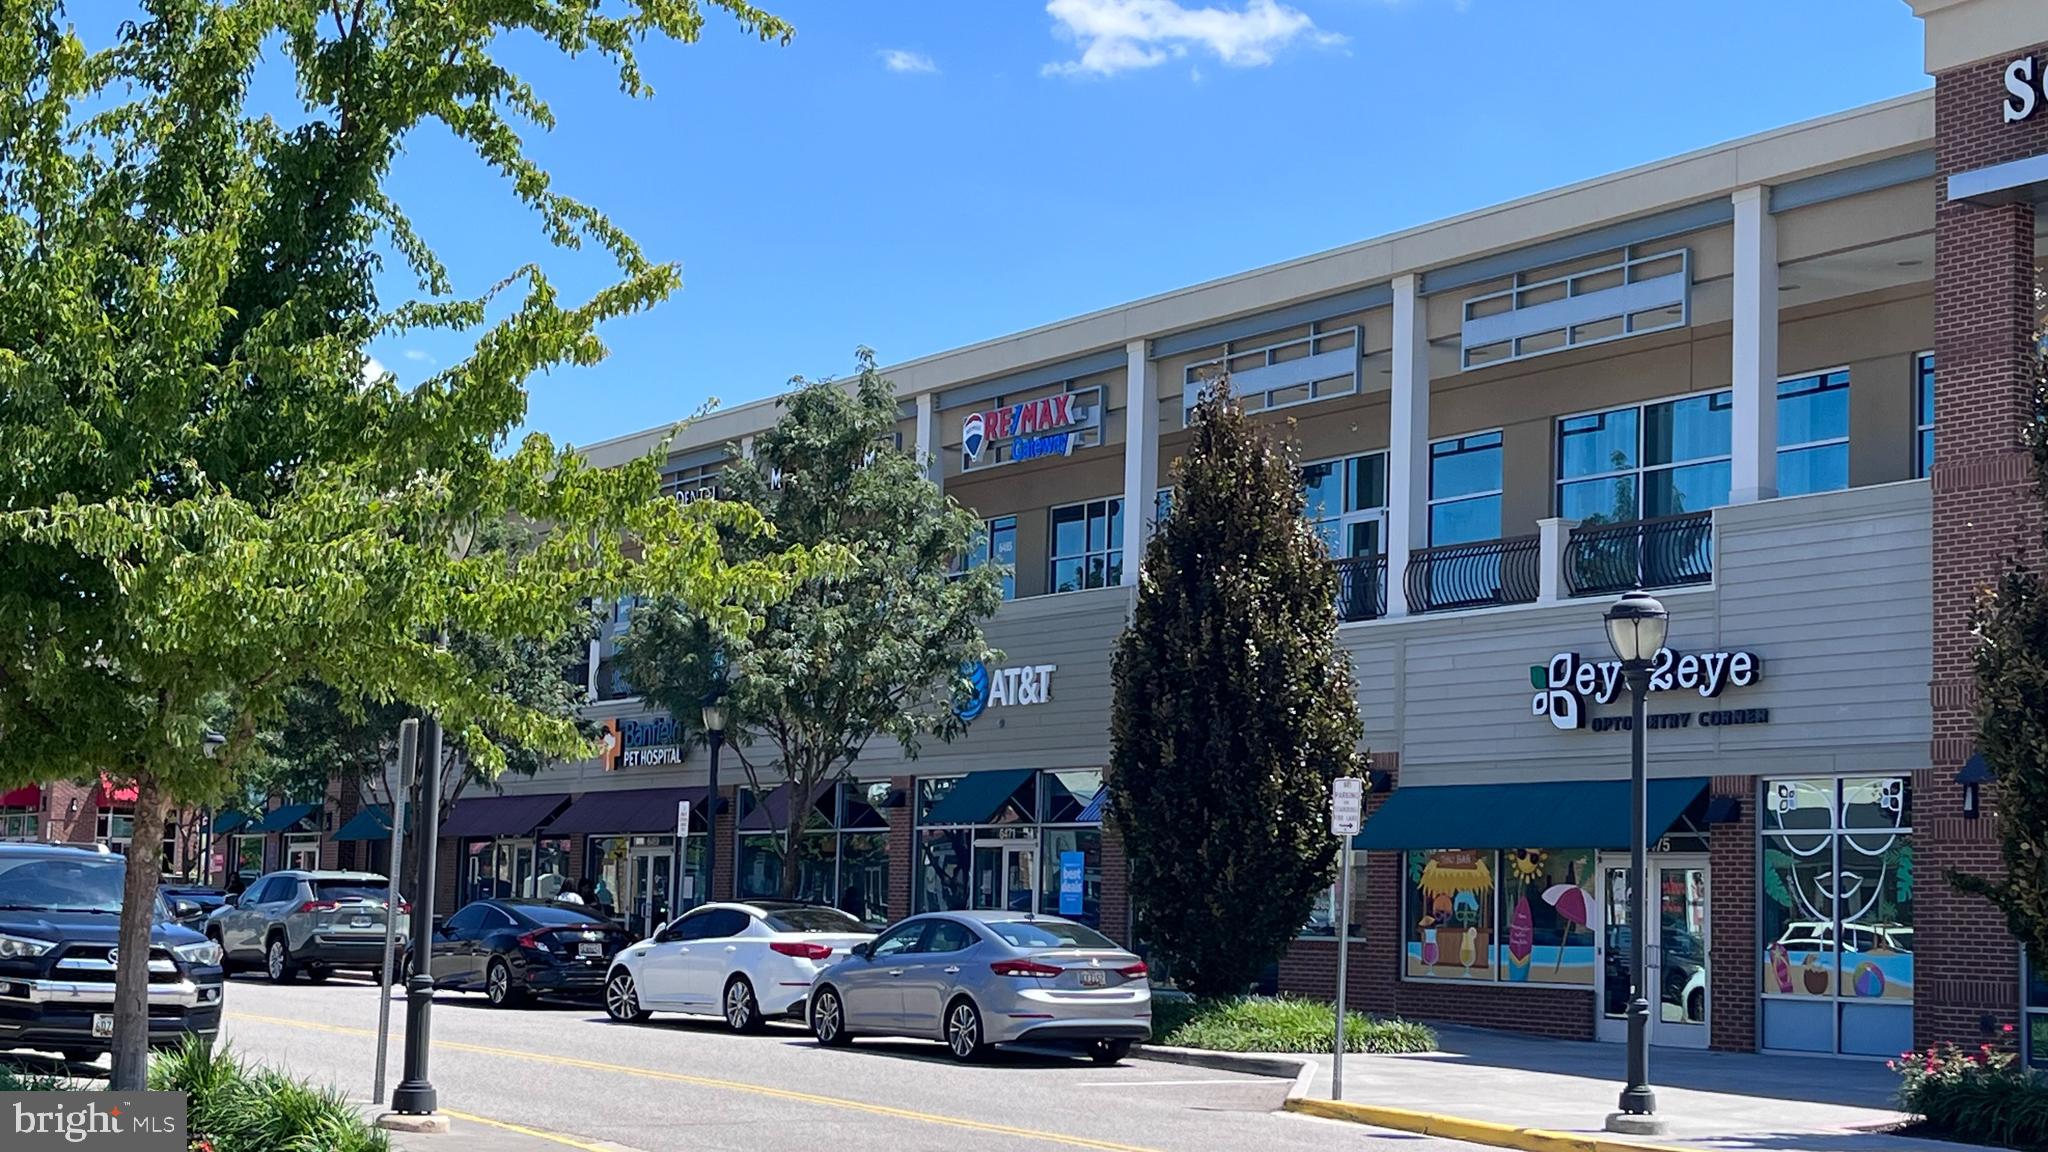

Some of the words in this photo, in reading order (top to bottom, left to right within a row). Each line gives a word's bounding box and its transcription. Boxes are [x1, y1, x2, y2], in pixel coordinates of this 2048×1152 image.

[2003, 55, 2048, 123] S
[984, 394, 1071, 441] RE/MAX
[1010, 431, 1069, 462] Gateway
[987, 664, 1057, 707] AT&T
[1576, 647, 1752, 704] ey2eye
[1591, 712, 1691, 732] OPTOETRY
[1698, 708, 1769, 727] CORNER
[623, 750, 640, 767] PET
[641, 747, 681, 765] HOSPITAL
[1063, 866, 1081, 880] best
